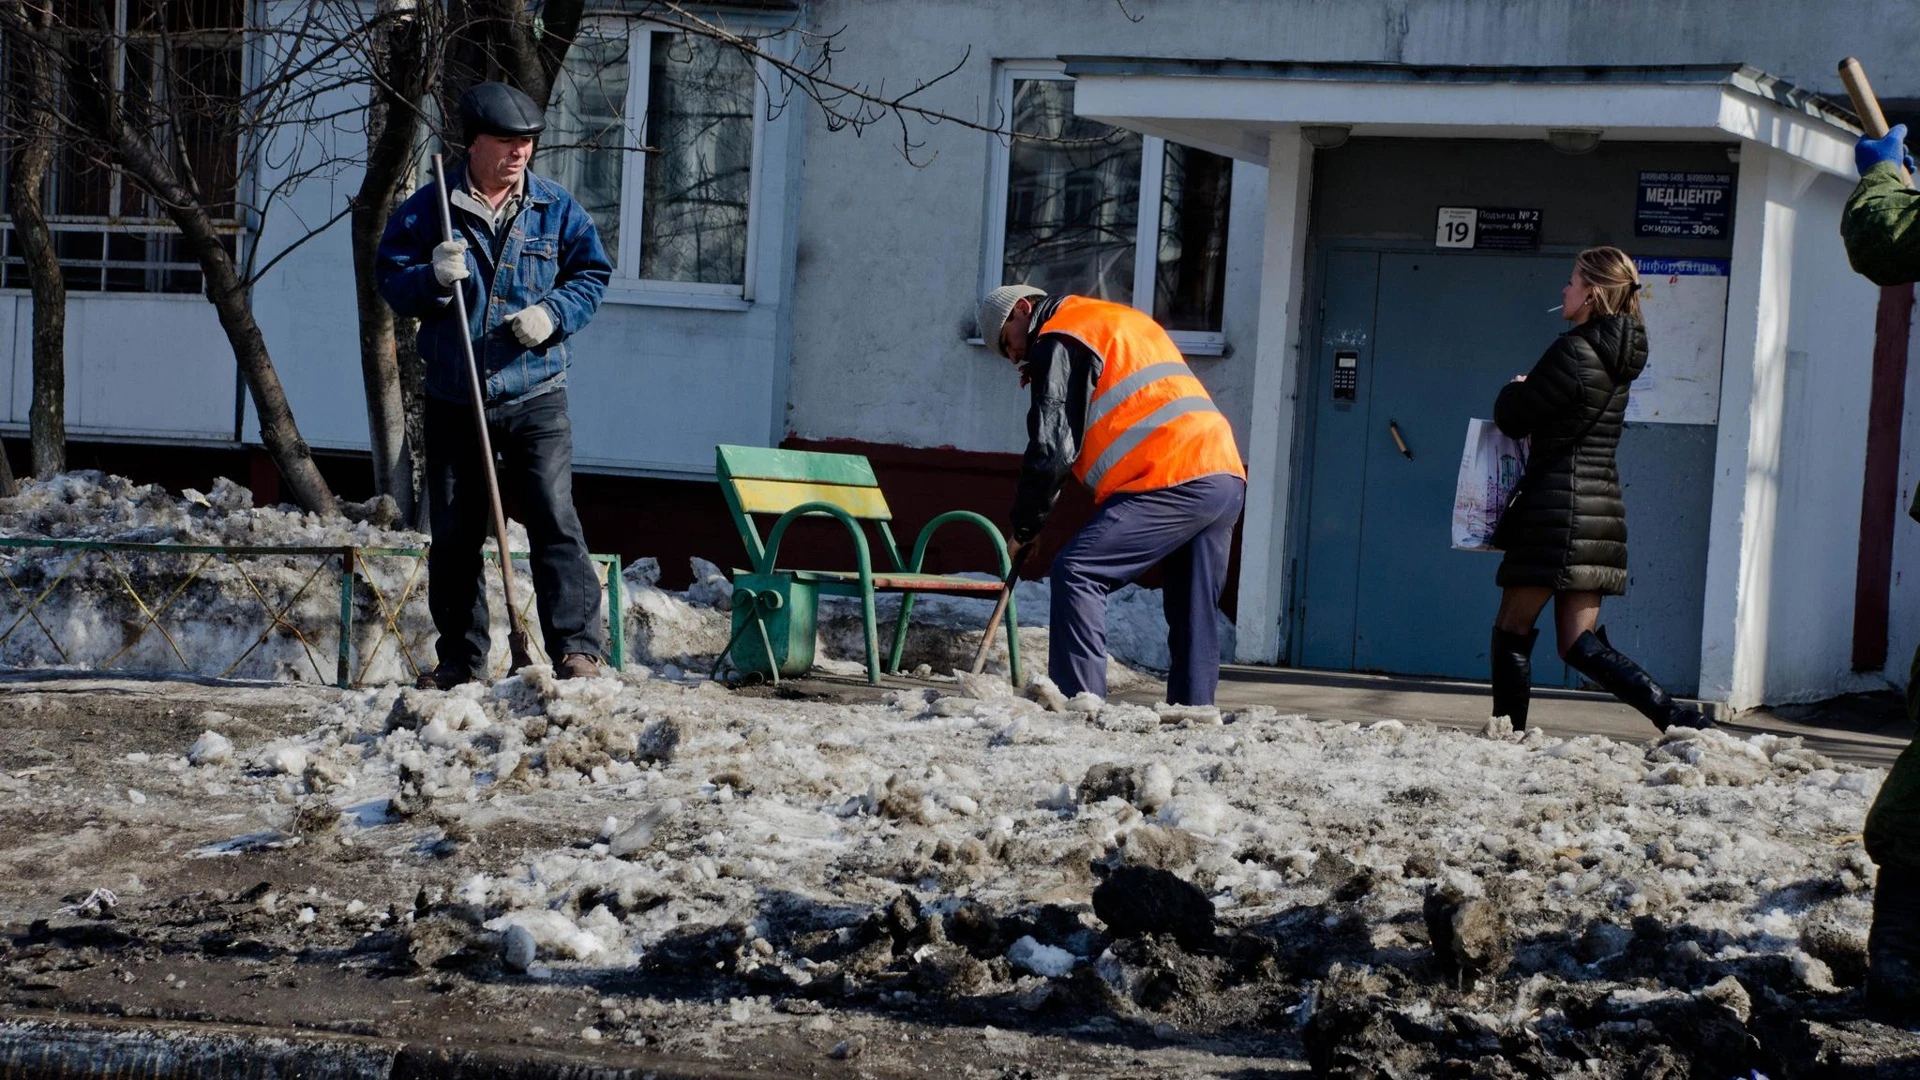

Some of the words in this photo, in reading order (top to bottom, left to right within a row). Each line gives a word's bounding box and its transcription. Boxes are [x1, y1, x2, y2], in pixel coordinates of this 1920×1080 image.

[1646, 187, 1722, 206] МЕД.ЦЕНТР
[1479, 210, 1515, 221] Подъезд
[1532, 211, 1539, 221] 2
[1445, 222, 1469, 243] 19
[1691, 225, 1719, 235] 30%
[1633, 259, 1717, 273] Информация
